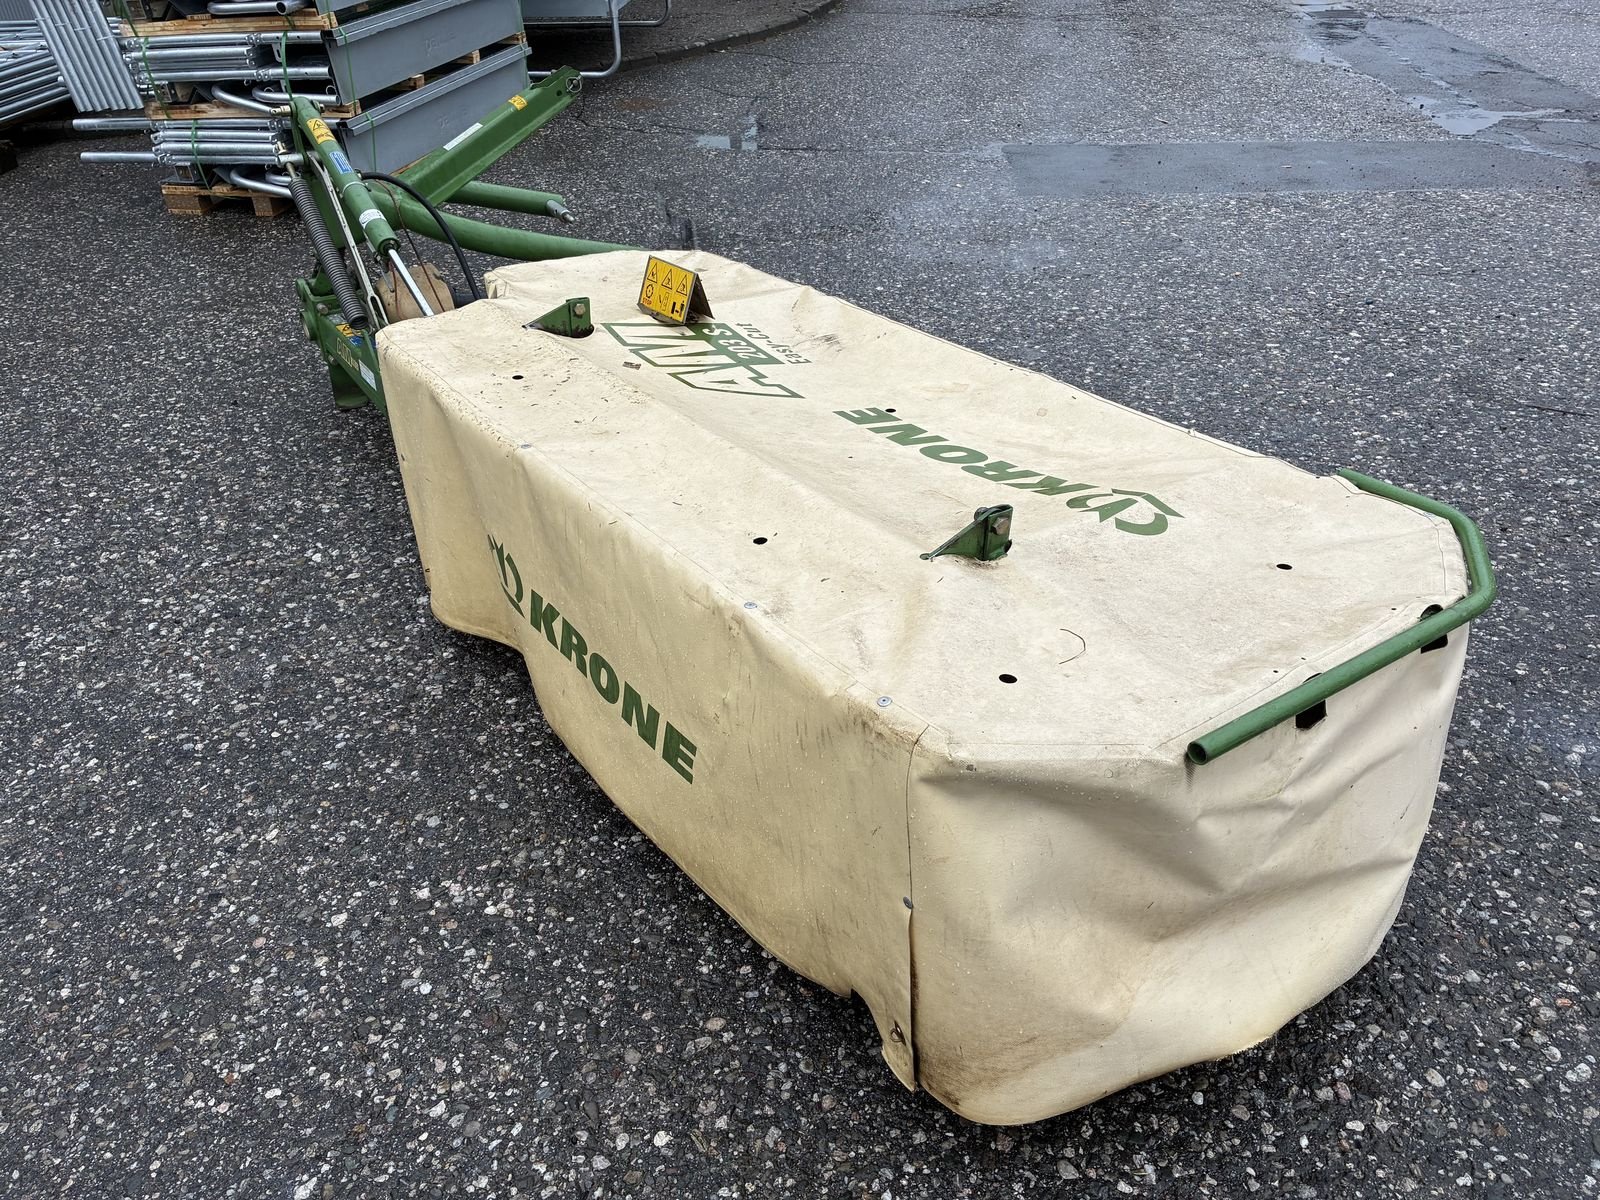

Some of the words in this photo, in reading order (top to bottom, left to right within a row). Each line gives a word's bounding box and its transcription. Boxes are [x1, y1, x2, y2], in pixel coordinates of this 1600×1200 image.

[701, 324, 733, 336] S
[718, 339, 768, 359] 203
[832, 407, 1100, 496] KRONE
[530, 588, 698, 785] KRONE
